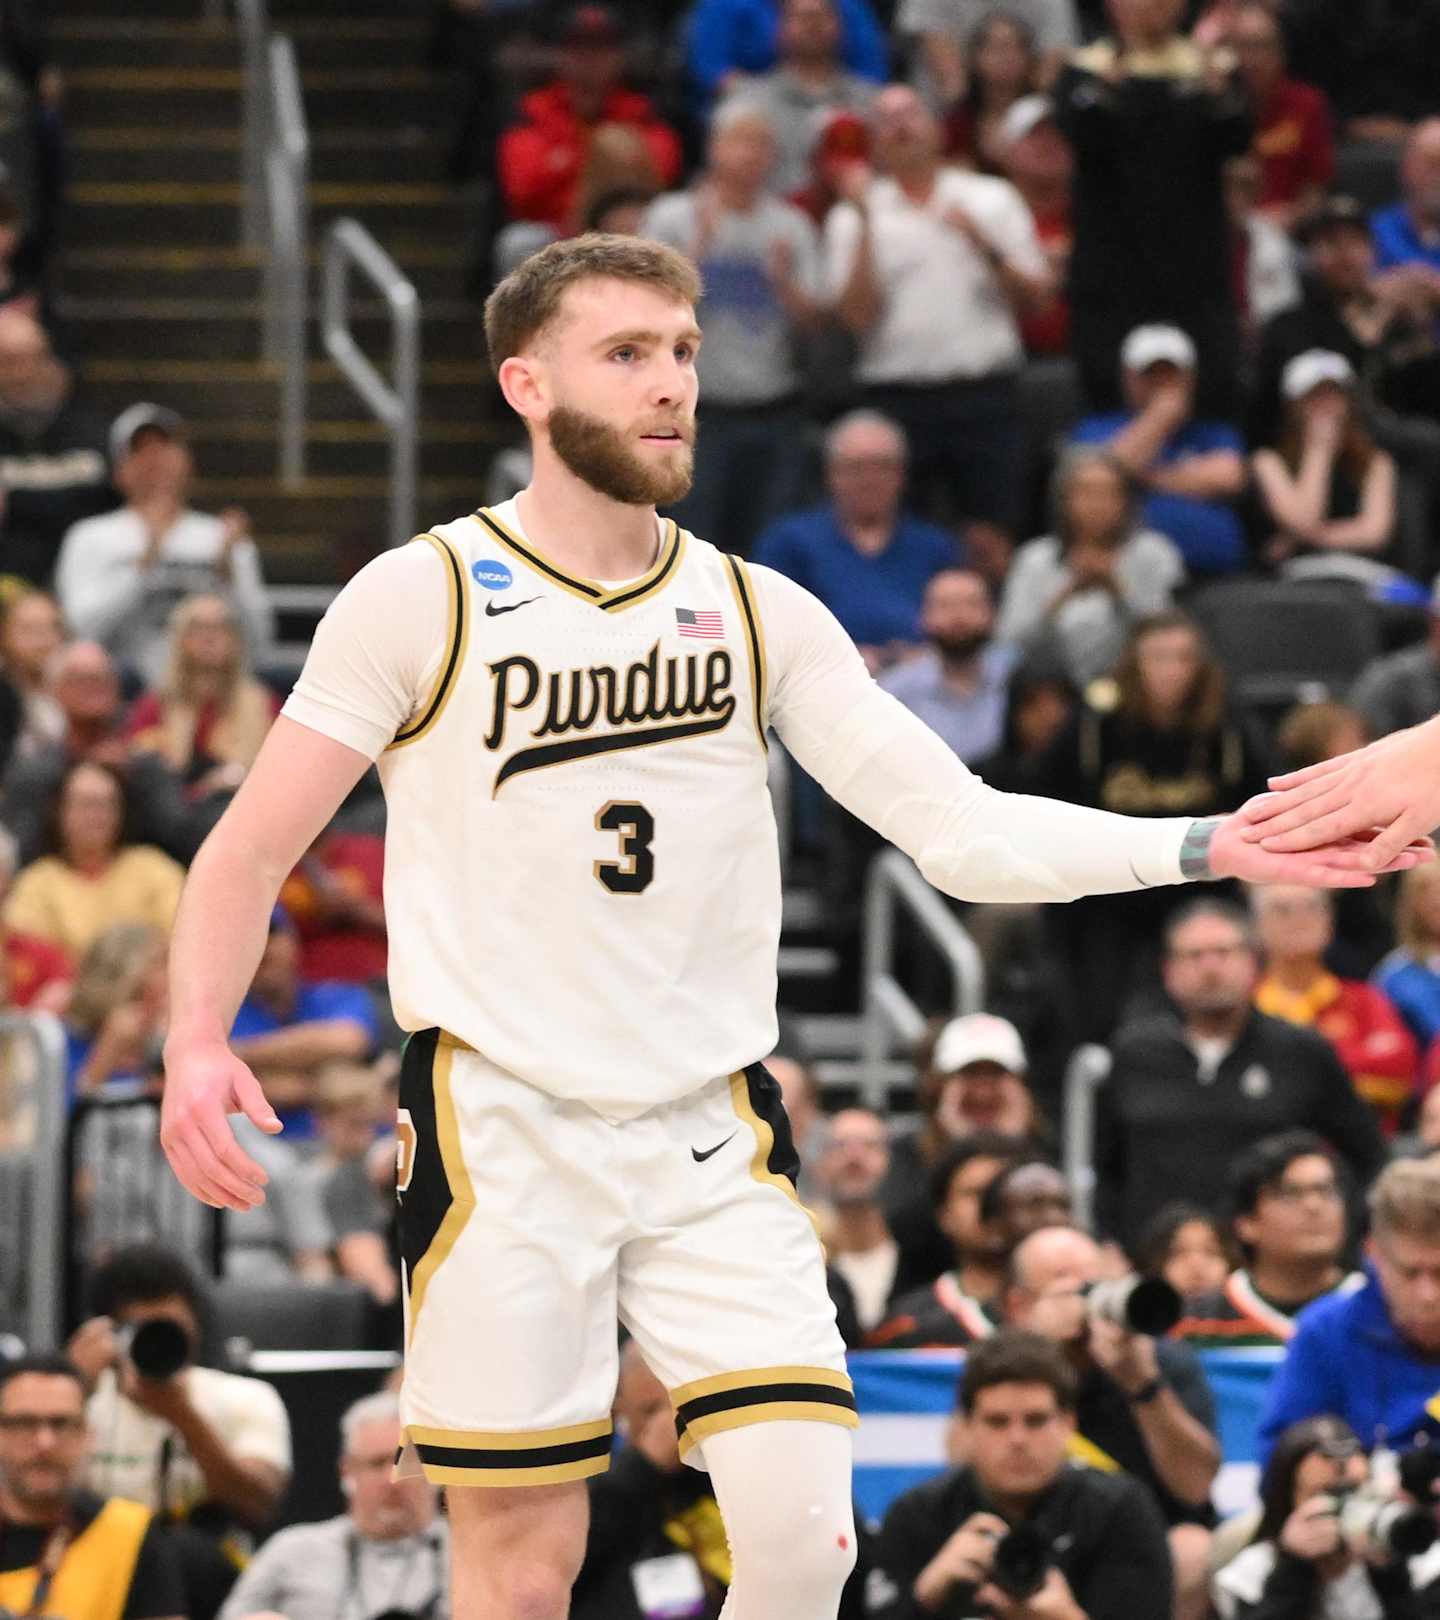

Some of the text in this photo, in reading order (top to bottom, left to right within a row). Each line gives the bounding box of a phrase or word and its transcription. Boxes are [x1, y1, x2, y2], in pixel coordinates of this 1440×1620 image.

[478, 571, 511, 583] NCAA
[484, 639, 736, 752] Purdue
[593, 799, 655, 895] 3
